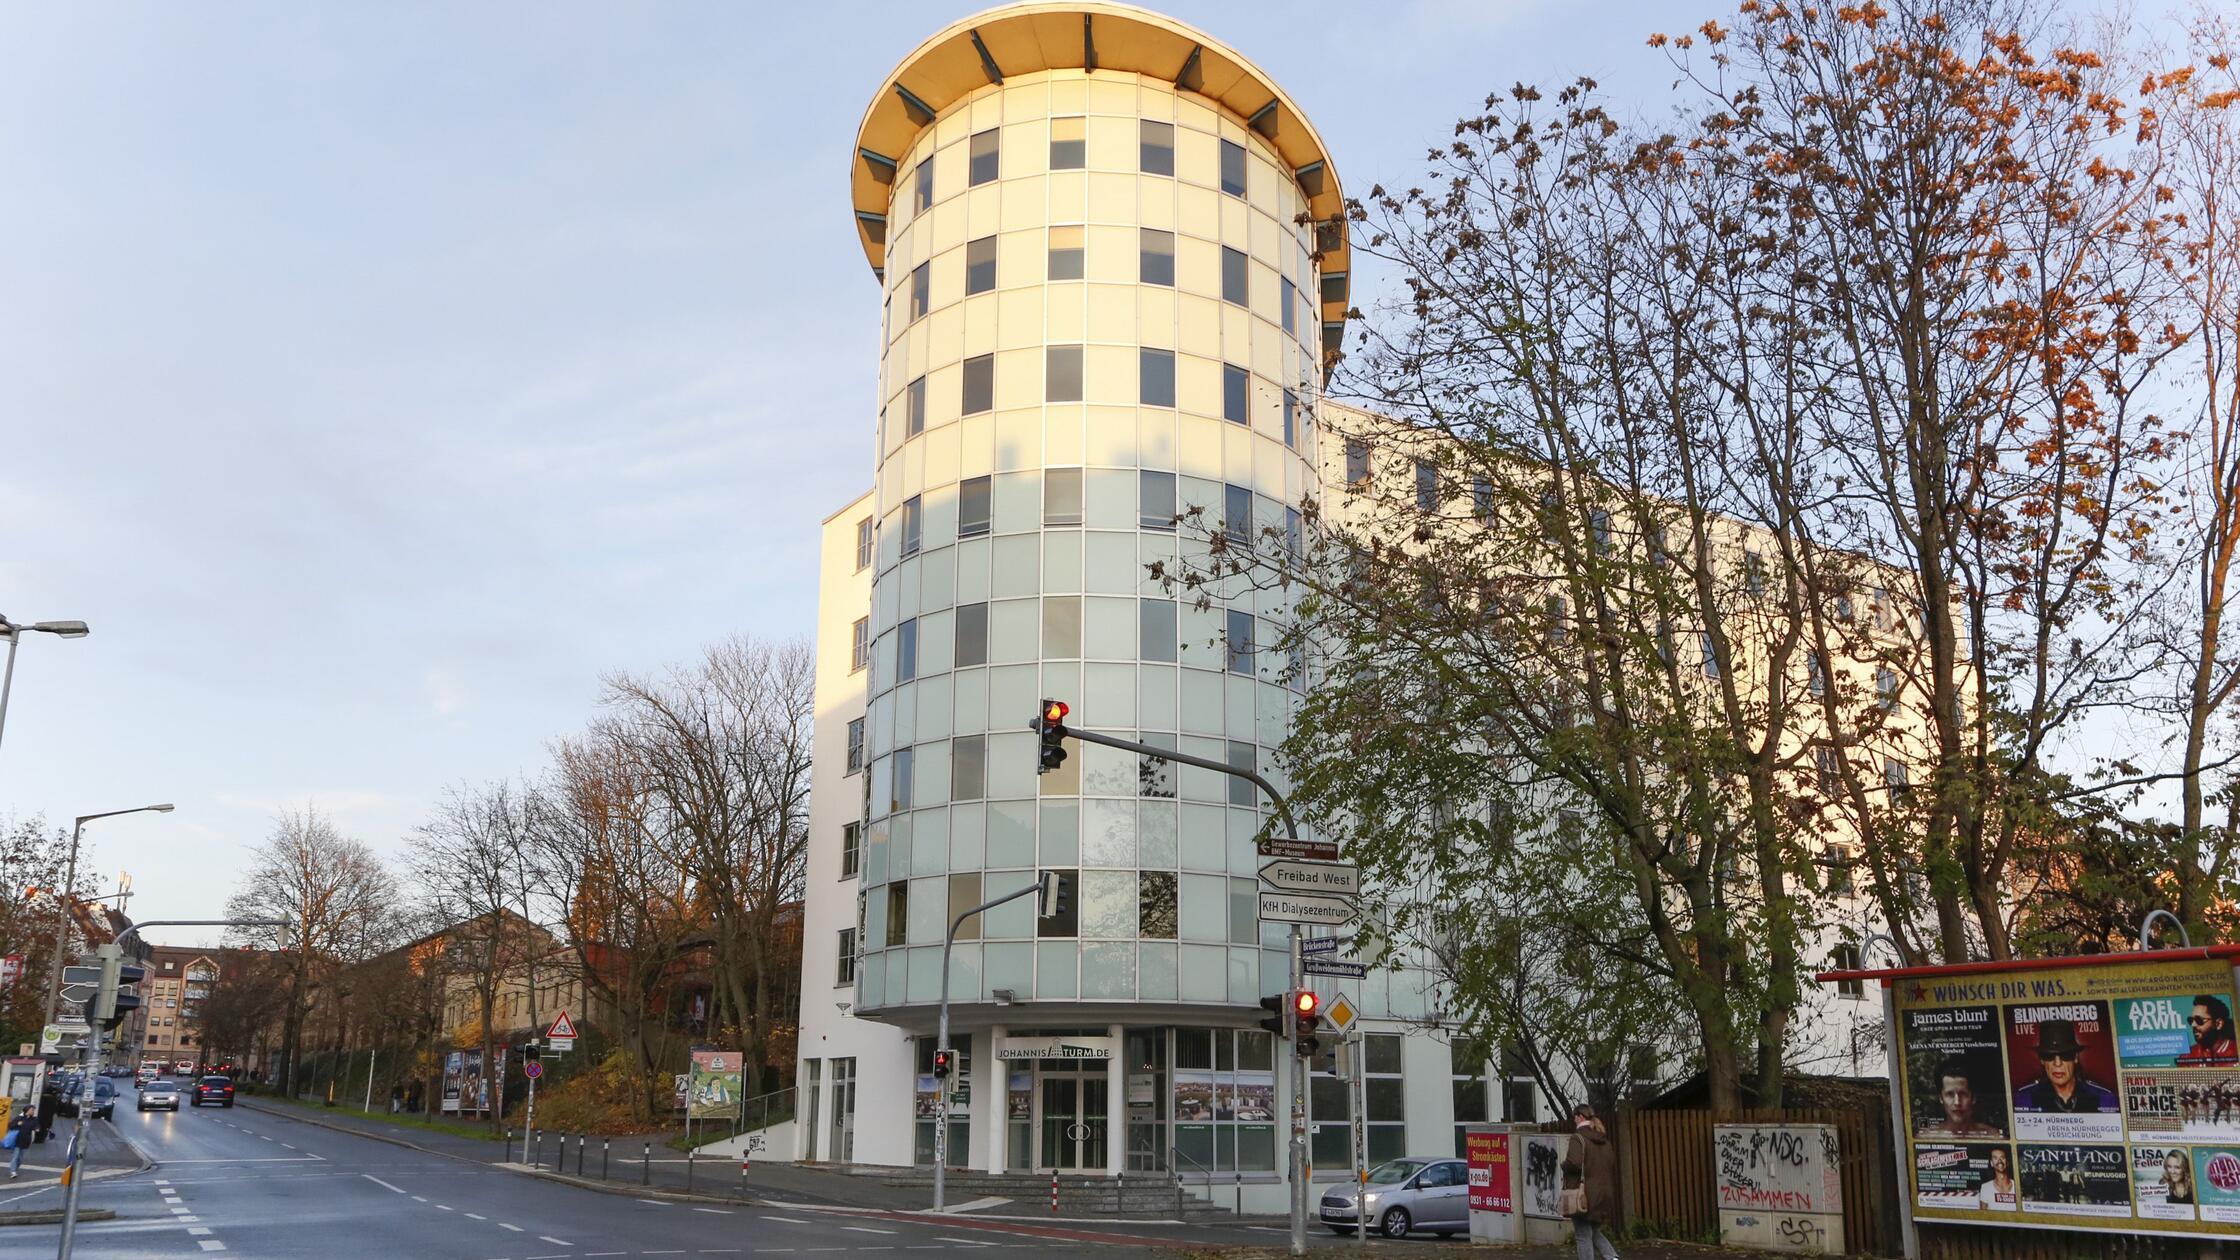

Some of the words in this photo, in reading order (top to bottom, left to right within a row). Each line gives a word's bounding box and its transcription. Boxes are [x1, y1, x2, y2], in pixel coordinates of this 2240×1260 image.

[1271, 840, 1312, 849] Gewerbezentrum
[1277, 870, 1318, 883] Freibad
[1324, 873, 1350, 885] West
[1262, 901, 1279, 913] KfH
[1282, 903, 1349, 918] Dialysezentrum
[1303, 939, 1335, 952] Brückenstraße
[1306, 963, 1362, 975] Großweidenmühlstraße
[1933, 982, 1996, 1002] WÜNSCH
[2001, 982, 2026, 999] DIR
[2023, 1004, 2098, 1023] LINDENBERG
[2129, 999, 2177, 1018] ADEL
[1912, 1011, 1952, 1027] james
[1954, 1009, 1988, 1023] blunt
[2130, 1013, 2187, 1031] TAWIL
[2015, 1024, 2035, 1035] LIVE
[2078, 1021, 2099, 1033] 2020
[999, 1049, 1047, 1058] JOHANNIS
[2127, 1086, 2147, 1095] LORD
[2149, 1086, 2158, 1095] OF
[2161, 1086, 2175, 1095] THE
[2046, 1116, 2084, 1124] NÜRNBERG
[2072, 1125, 2120, 1133] NÜRNBERGER
[1467, 1136, 1491, 1149] Werbung
[1491, 1136, 1500, 1149] auf
[1472, 1150, 1506, 1163] Stromkästen
[2023, 1147, 2122, 1164] SANTIANO
[2133, 1149, 2165, 1160] LISA
[2134, 1158, 2164, 1168] Feller
[1470, 1195, 1482, 1205] 0931
[1500, 1197, 1510, 1208] 112
[1720, 1186, 1812, 1210] ZUSAMMEN
